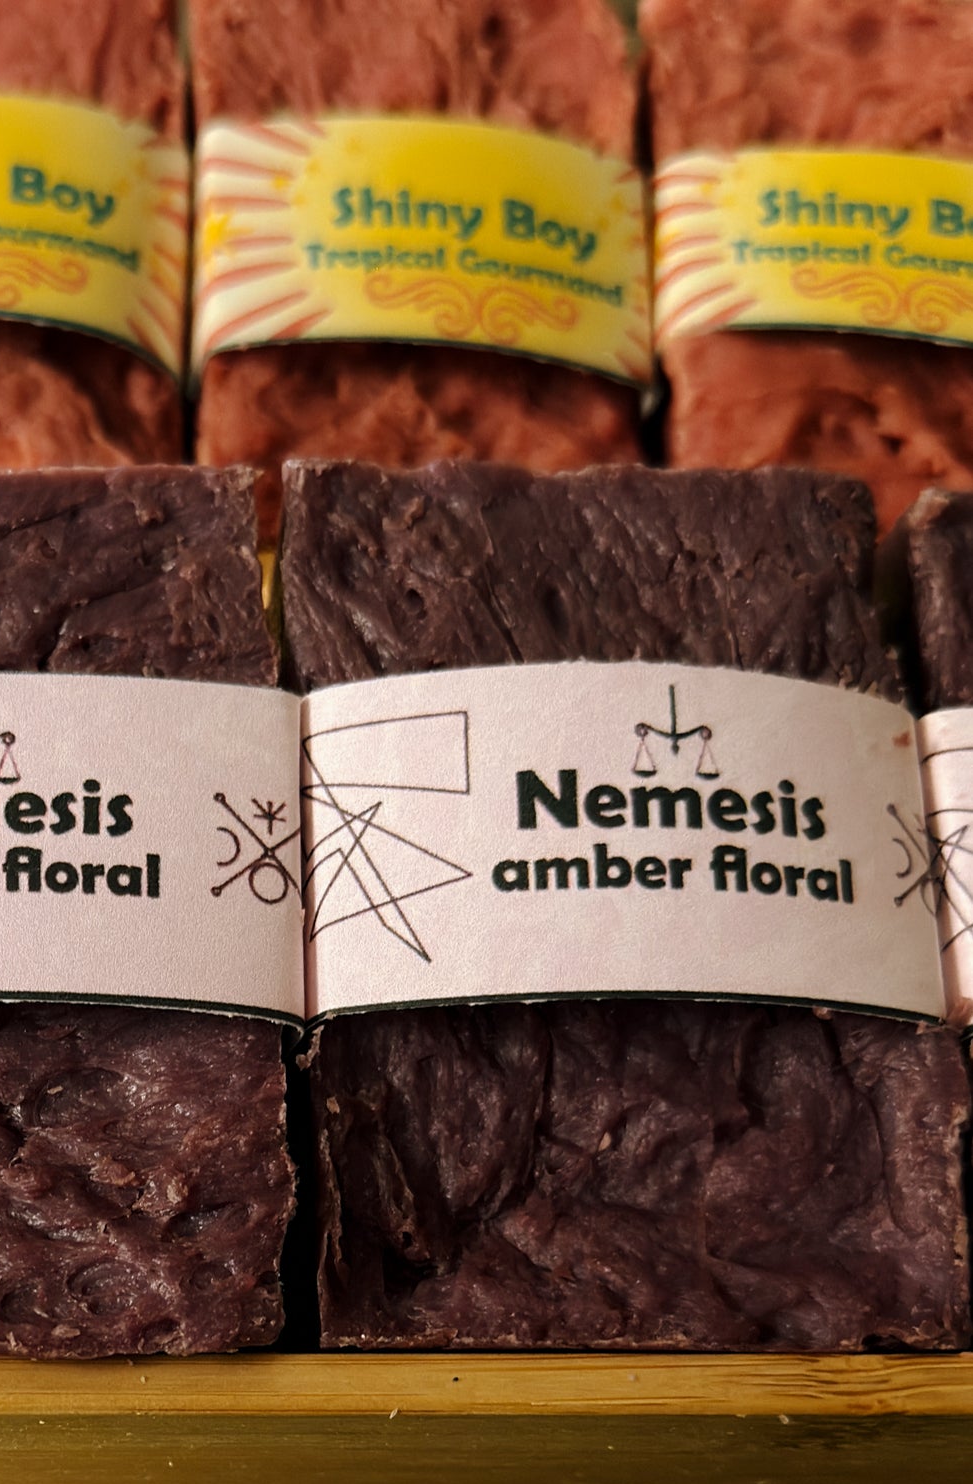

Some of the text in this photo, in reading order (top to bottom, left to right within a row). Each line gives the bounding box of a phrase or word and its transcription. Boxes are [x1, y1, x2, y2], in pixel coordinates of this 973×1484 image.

[10, 164, 117, 227] Boy
[332, 186, 599, 261] Shiny Boy
[760, 188, 911, 239] Shiny
[304, 242, 625, 308] Tropical Gourmand
[731, 240, 872, 265] Tropical
[516, 768, 826, 840] Nemesis
[2, 846, 160, 898] floral
[492, 842, 854, 904] amber floral
